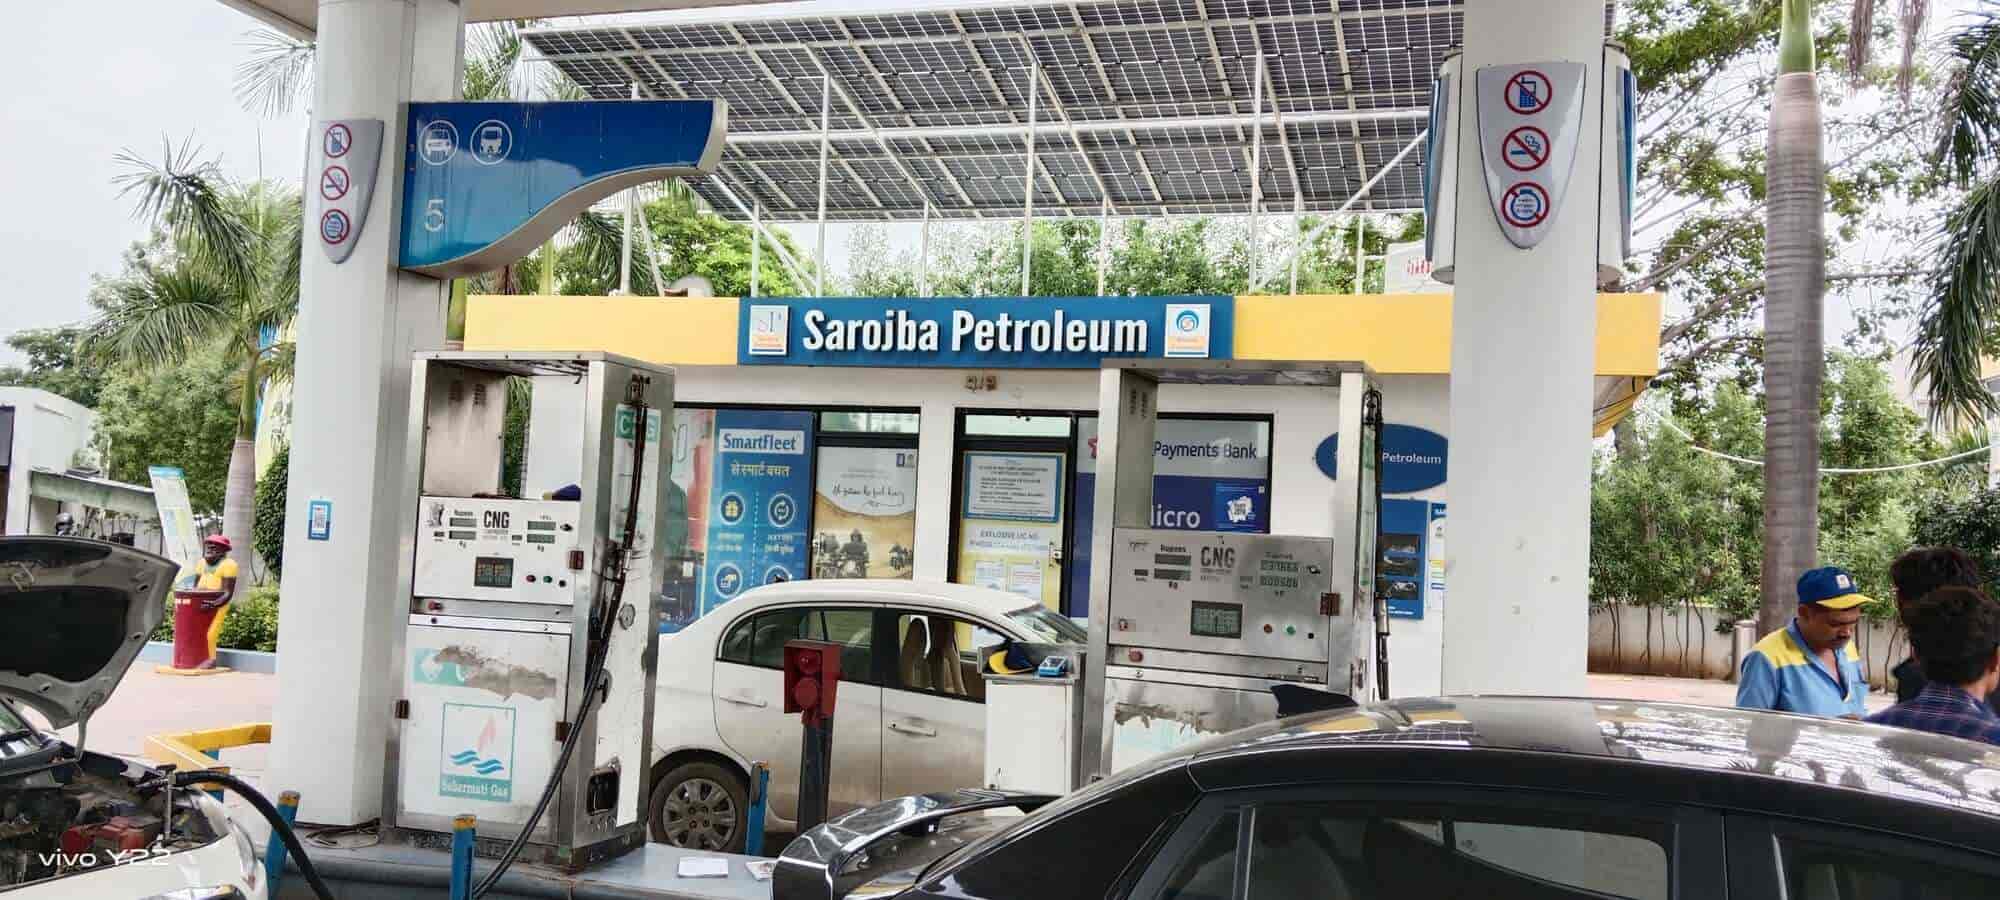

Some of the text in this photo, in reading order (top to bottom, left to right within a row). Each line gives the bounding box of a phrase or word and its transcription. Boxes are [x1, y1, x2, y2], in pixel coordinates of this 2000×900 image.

[424, 199, 445, 232] 5
[802, 309, 1148, 352] Sarojba Petroleum
[1153, 440, 1257, 460] Payments Bank
[1382, 452, 1442, 465] Petroleum
[483, 510, 510, 529] CNG
[1151, 503, 1201, 529] icro
[1200, 546, 1235, 569] CNG
